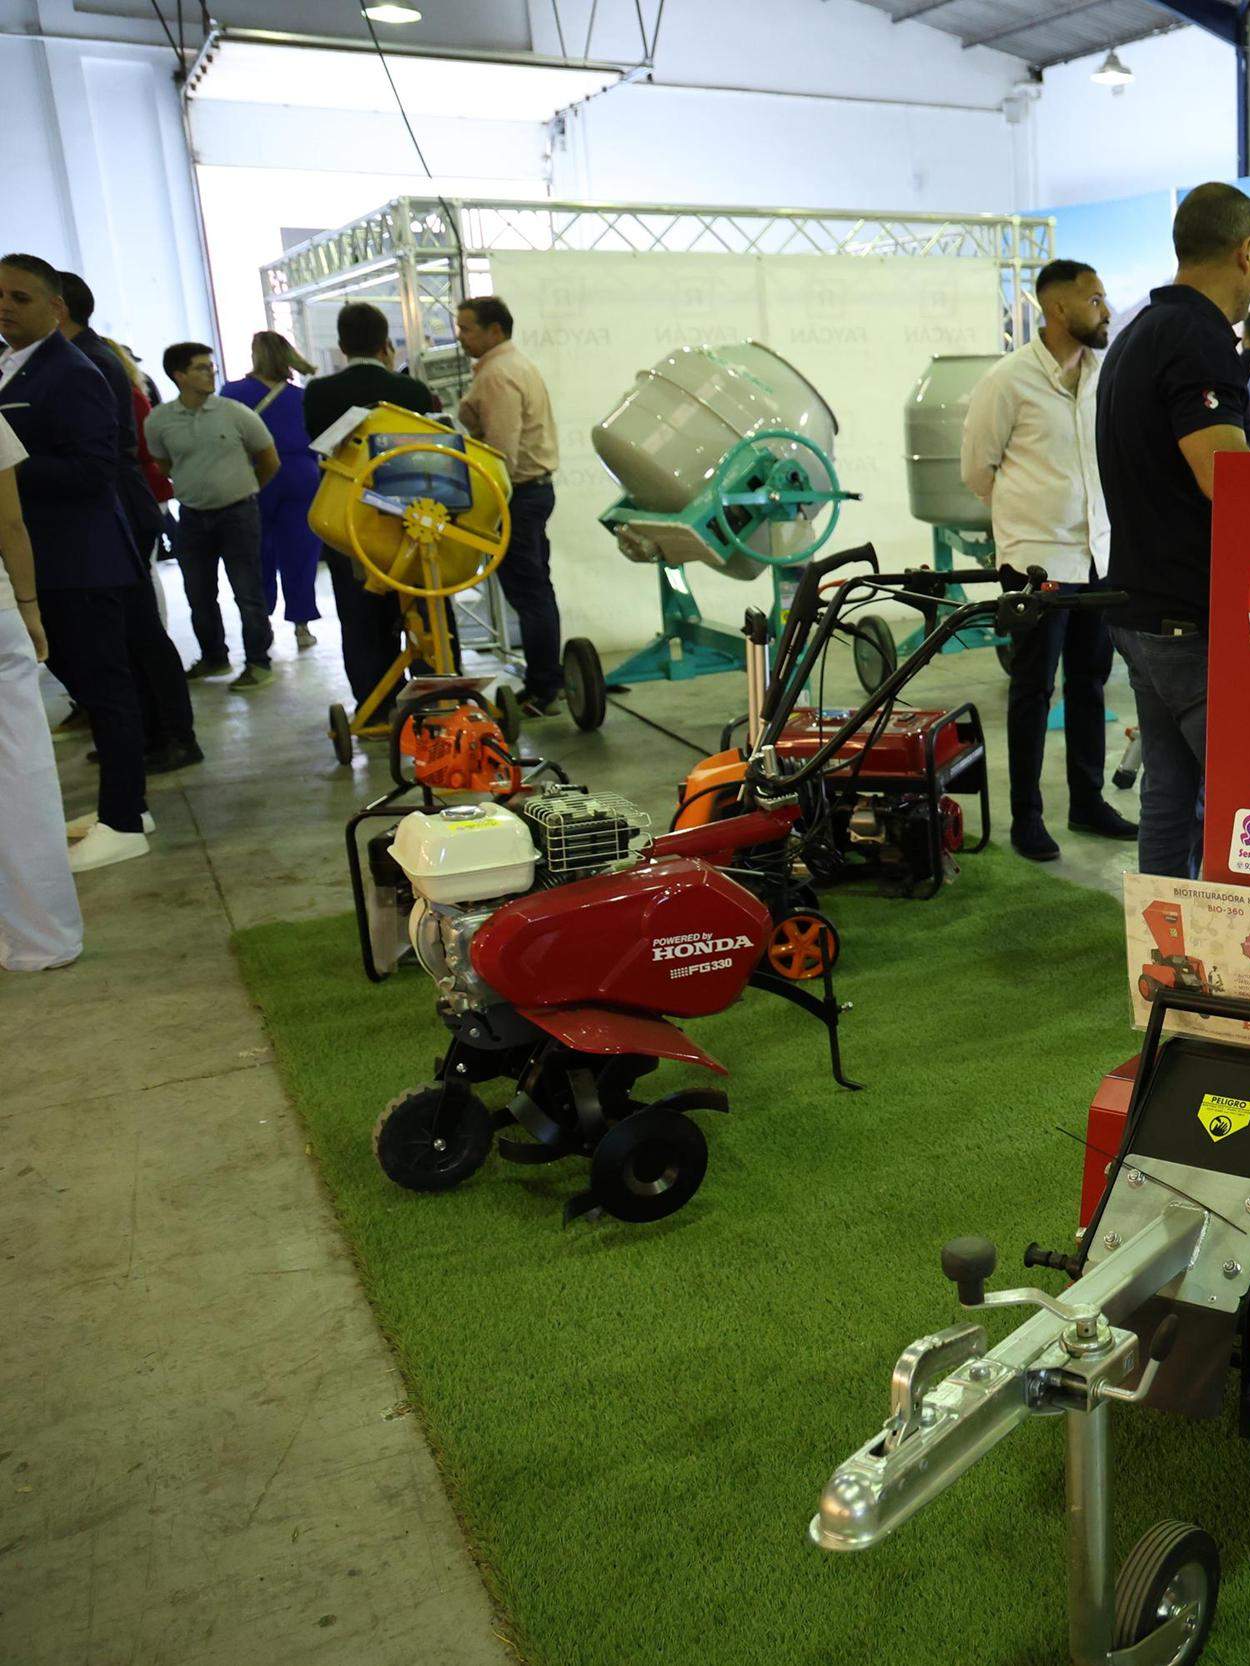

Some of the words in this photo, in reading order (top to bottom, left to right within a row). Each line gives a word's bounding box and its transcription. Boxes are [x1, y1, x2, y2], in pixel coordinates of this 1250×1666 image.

[1173, 888, 1245, 904] BIOTRITURADORA
[1207, 904, 1245, 916] BIO-360
[652, 933, 701, 947] POWERED
[701, 932, 713, 941] by
[652, 935, 755, 962] HONDA
[688, 957, 733, 976] FG330
[1211, 1096, 1247, 1109] PELIGRO
